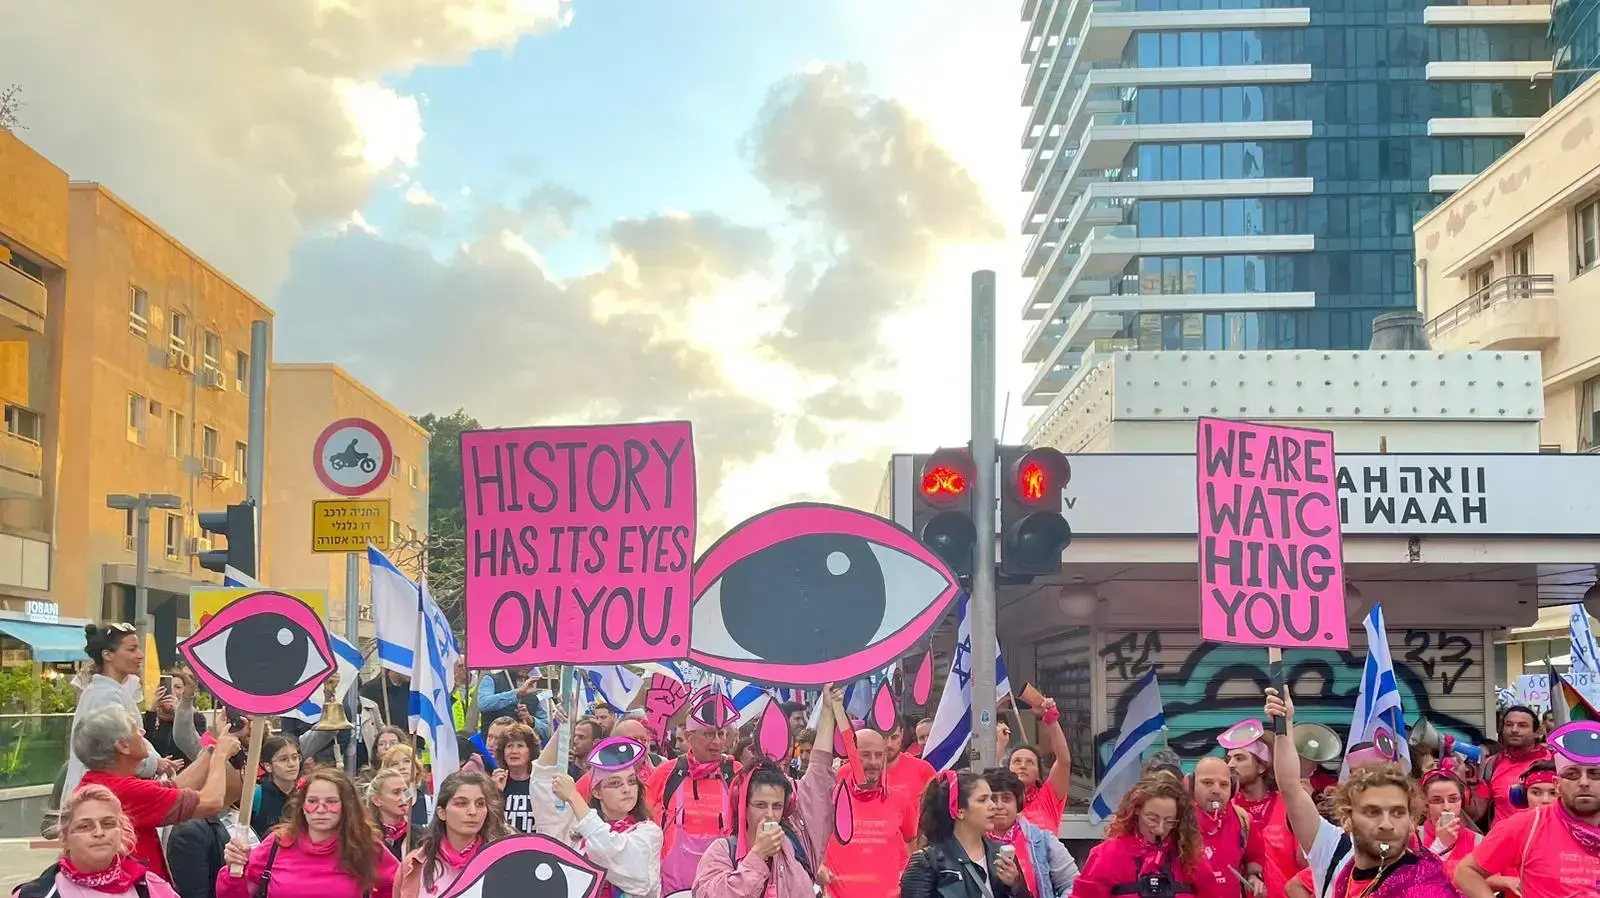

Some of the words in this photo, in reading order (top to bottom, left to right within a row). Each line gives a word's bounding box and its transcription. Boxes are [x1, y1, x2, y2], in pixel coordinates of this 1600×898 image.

[1205, 424, 1256, 477] WE
[1260, 436, 1328, 483] ARE
[471, 438, 685, 516] HISTORY
[1399, 466, 1486, 493] וואה
[323, 506, 347, 517] לרכב
[331, 520, 357, 531] גלגלי
[350, 507, 380, 517] החניה
[361, 521, 372, 531] דו
[1206, 482, 1332, 539] WATC
[1364, 497, 1487, 524] WAAH
[317, 535, 349, 545] אסורה
[474, 525, 539, 577] HAS
[548, 525, 608, 574] ITS
[618, 524, 690, 574] EYES
[1205, 536, 1335, 592] HING
[489, 586, 562, 654] ON
[571, 585, 681, 651] YOU.
[1211, 588, 1334, 641] YOU.
